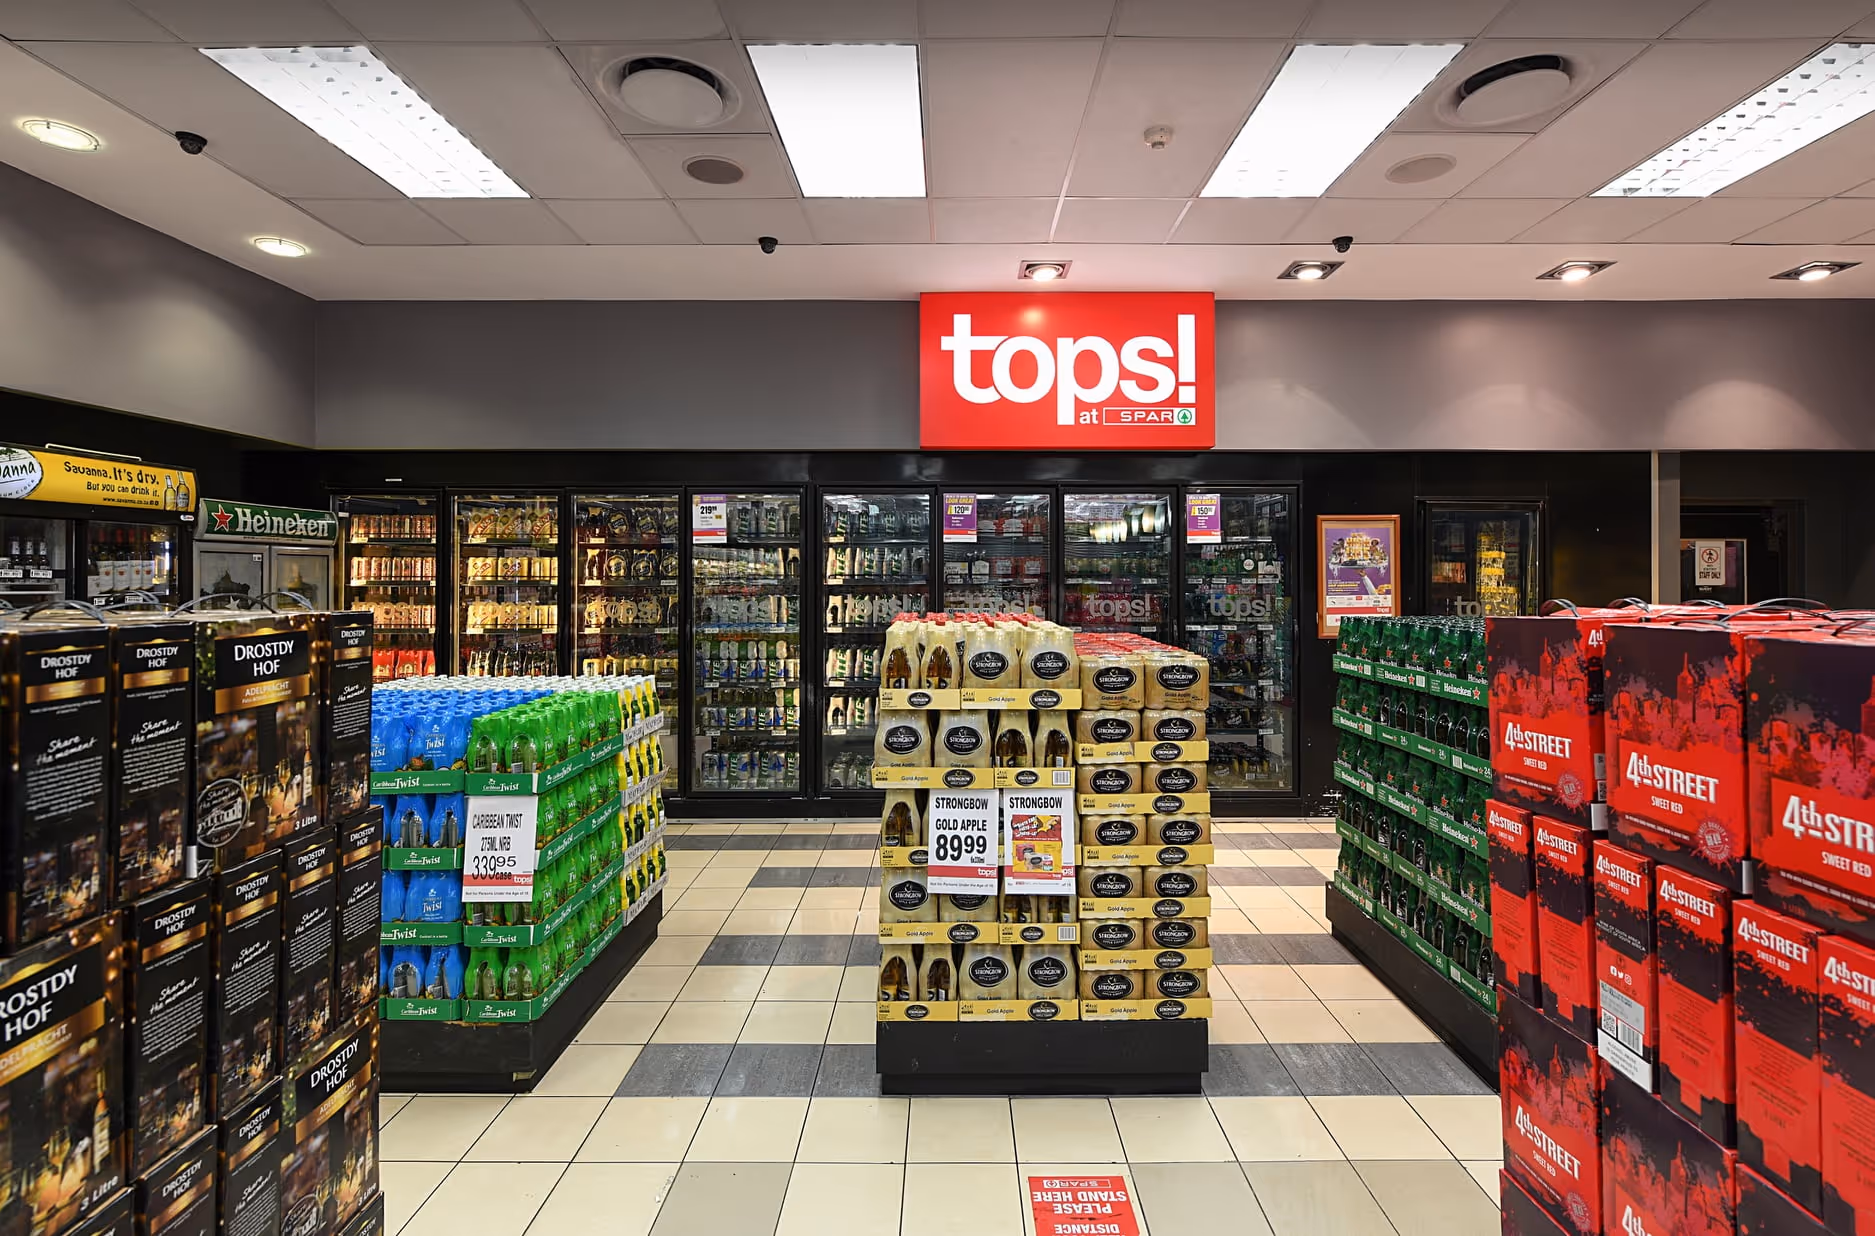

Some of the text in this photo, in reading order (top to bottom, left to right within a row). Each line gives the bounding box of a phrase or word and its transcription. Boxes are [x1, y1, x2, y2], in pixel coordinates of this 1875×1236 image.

[940, 313, 1196, 425] tops!
[1079, 408, 1173, 425] at SPAR
[64, 461, 160, 485] Savanna. It's dry.
[86, 481, 160, 497] But you can drink it.
[235, 507, 330, 537] Heineken
[1087, 593, 1151, 620] tops!
[1208, 593, 1271, 620] tops!
[341, 629, 365, 639] DROSTDY
[348, 637, 359, 646] HOF
[136, 646, 179, 659] DROSTDY
[234, 640, 295, 662] DROSTDY
[41, 654, 92, 669] DROSTDY
[148, 657, 168, 668] HOF
[253, 659, 281, 677] HOF
[55, 667, 79, 679] HOF
[712, 660, 721, 681] LITE
[1384, 670, 1408, 683] Heineken
[245, 681, 290, 697] ADELPRACHT
[338, 686, 367, 703] the moment
[343, 684, 359, 695] Share
[1443, 682, 1472, 697] Heineken
[729, 712, 737, 730] LITE
[48, 735, 81, 752] Share
[425, 737, 445, 750] Twist
[1504, 722, 1572, 759] 4th STREET
[36, 737, 98, 766] the moment
[730, 757, 738, 775] LITE
[1523, 756, 1548, 771] SWEET RED
[395, 776, 420, 788] Twist
[1626, 751, 1720, 804] 4th STREET
[499, 782, 519, 793] Twist
[935, 797, 988, 810] STRONGBOW
[1009, 796, 1063, 809] STRONGBOW
[1388, 795, 1410, 812] Heineken
[1651, 795, 1684, 815] SWEET RED
[295, 814, 317, 831] 3 Litre
[472, 813, 523, 829] CARIBBEAN TWIST
[935, 818, 987, 831] GOLD APPLE
[1782, 795, 1824, 839] 4th
[350, 826, 376, 842] DROSTDY
[356, 836, 368, 847] HOF
[1441, 822, 1470, 844] Heineken
[481, 836, 511, 851] 275ML NRB
[421, 854, 441, 865] Twist
[1821, 851, 1873, 878] SWEET RED
[495, 871, 512, 880] case
[513, 876, 533, 884] tops!
[977, 868, 997, 878] tops!
[1596, 854, 1643, 889] 4th STREET
[236, 875, 270, 896] DROSTDY
[244, 888, 261, 902] HOF
[422, 900, 443, 914] Twist
[1441, 892, 1469, 916] Heineken
[392, 928, 418, 940] Twist
[498, 935, 517, 944] Twist
[1737, 917, 1810, 965] 4th STREET
[231, 939, 272, 973] the moment
[239, 941, 261, 961] Share
[974, 967, 1002, 975] STRONGBOW
[5, 1000, 53, 1041] HOF
[310, 1038, 360, 1089] DROSTDY
[325, 1064, 349, 1093] HOF
[239, 1106, 271, 1138] DROSTDY
[247, 1123, 264, 1140] HOF
[1515, 1105, 1581, 1181] 4th STREET
[92, 1175, 119, 1200] Litre
[1032, 1191, 1127, 1202] STAND HERE
[1052, 1203, 1113, 1214] PLEASE
[1054, 1223, 1120, 1234] DISTANCE
